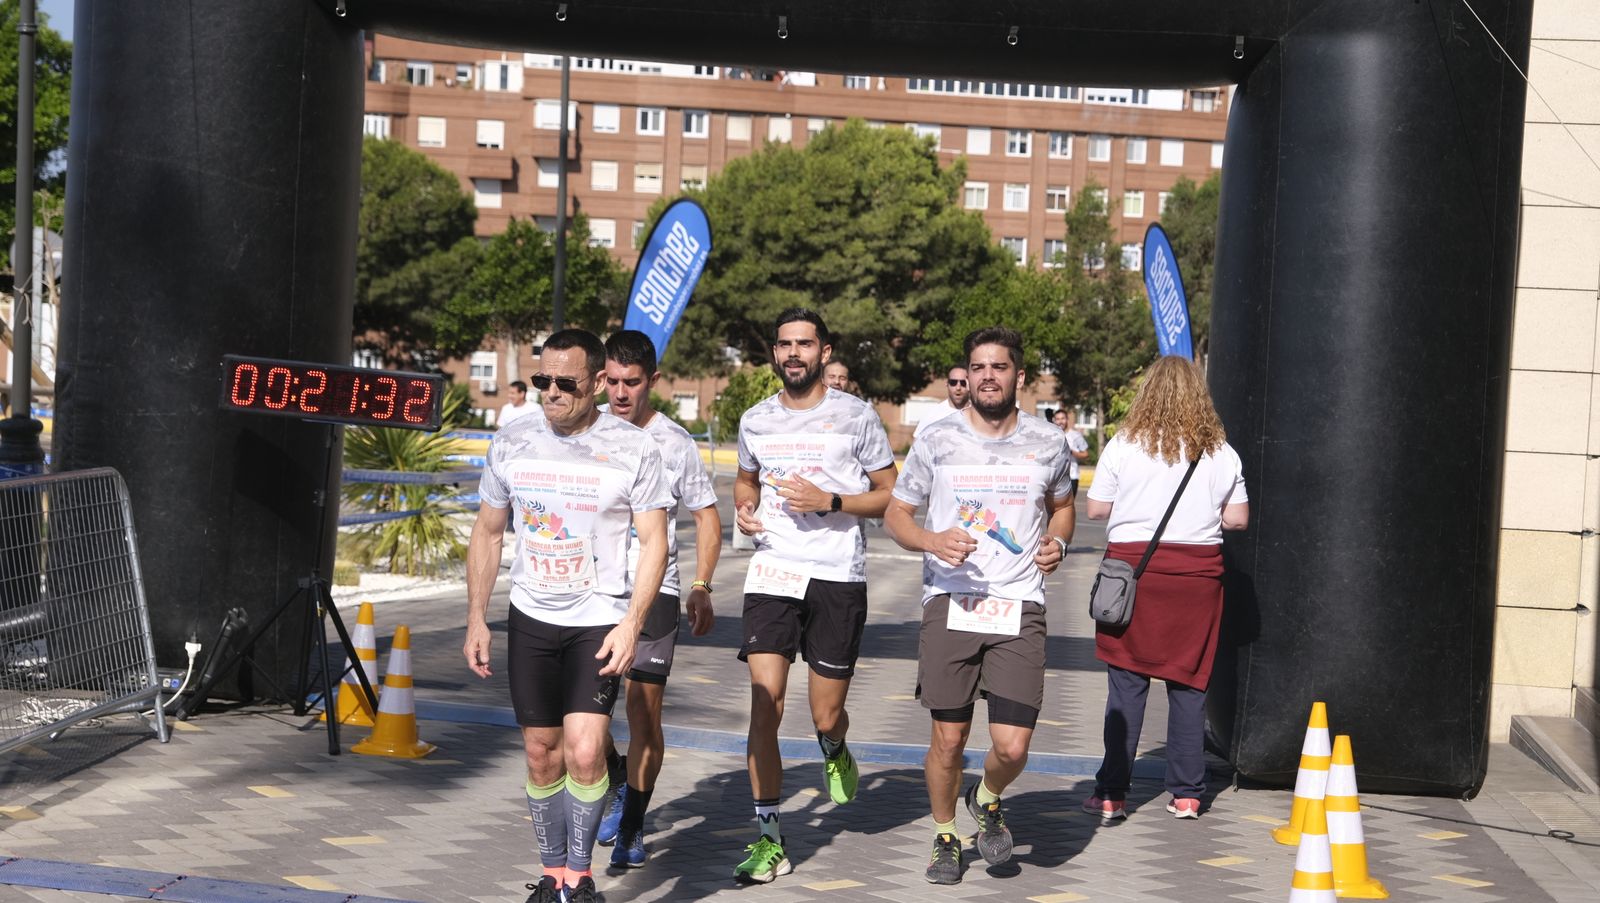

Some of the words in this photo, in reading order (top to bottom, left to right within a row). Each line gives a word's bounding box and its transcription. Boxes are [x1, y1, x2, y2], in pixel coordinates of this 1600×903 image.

[574, 502, 599, 512] JUNIO
[530, 555, 585, 575] 1157
[960, 596, 1014, 617] 1037
[530, 801, 553, 854] kalenji
[571, 802, 593, 858] kalenji
